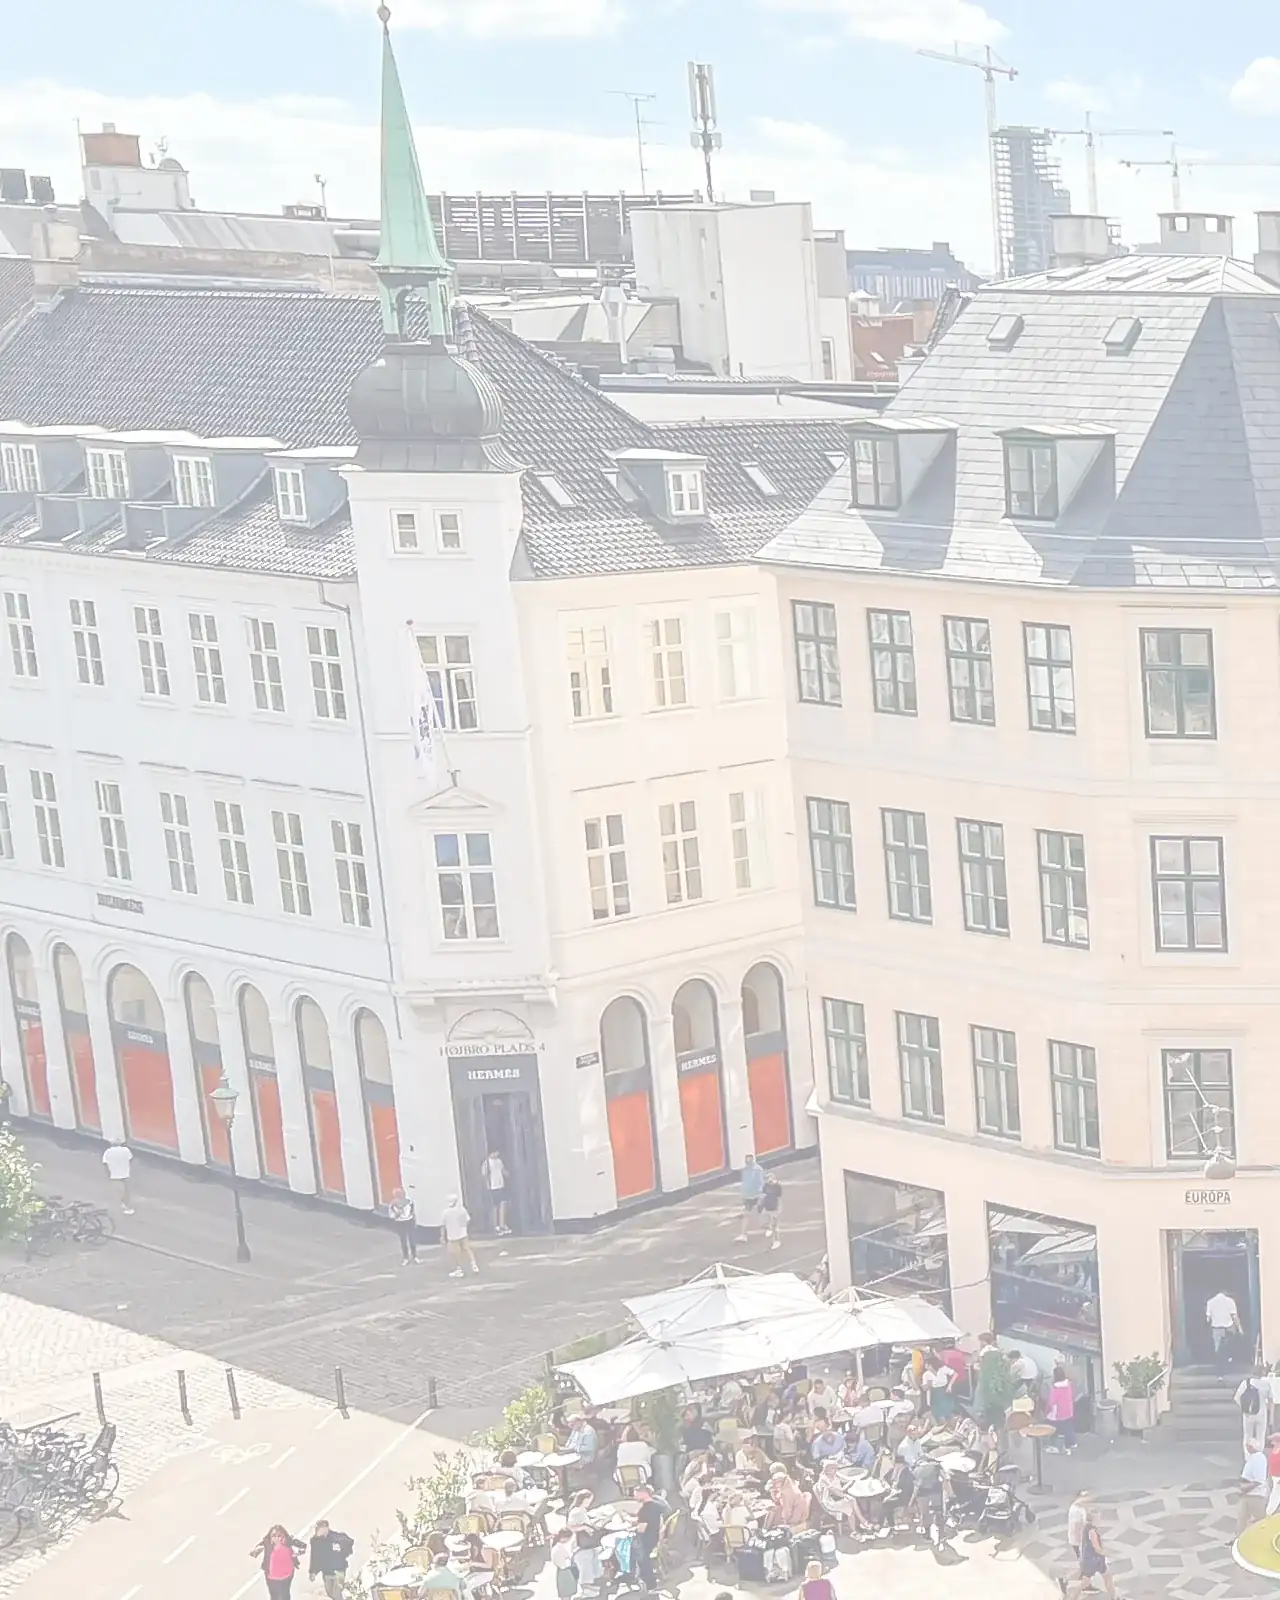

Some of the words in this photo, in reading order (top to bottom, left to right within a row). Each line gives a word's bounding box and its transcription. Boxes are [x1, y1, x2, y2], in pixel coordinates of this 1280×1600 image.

[494, 1043, 534, 1054] PLADS
[539, 1042, 546, 1052] 4
[1185, 1191, 1231, 1203] EUROPA
